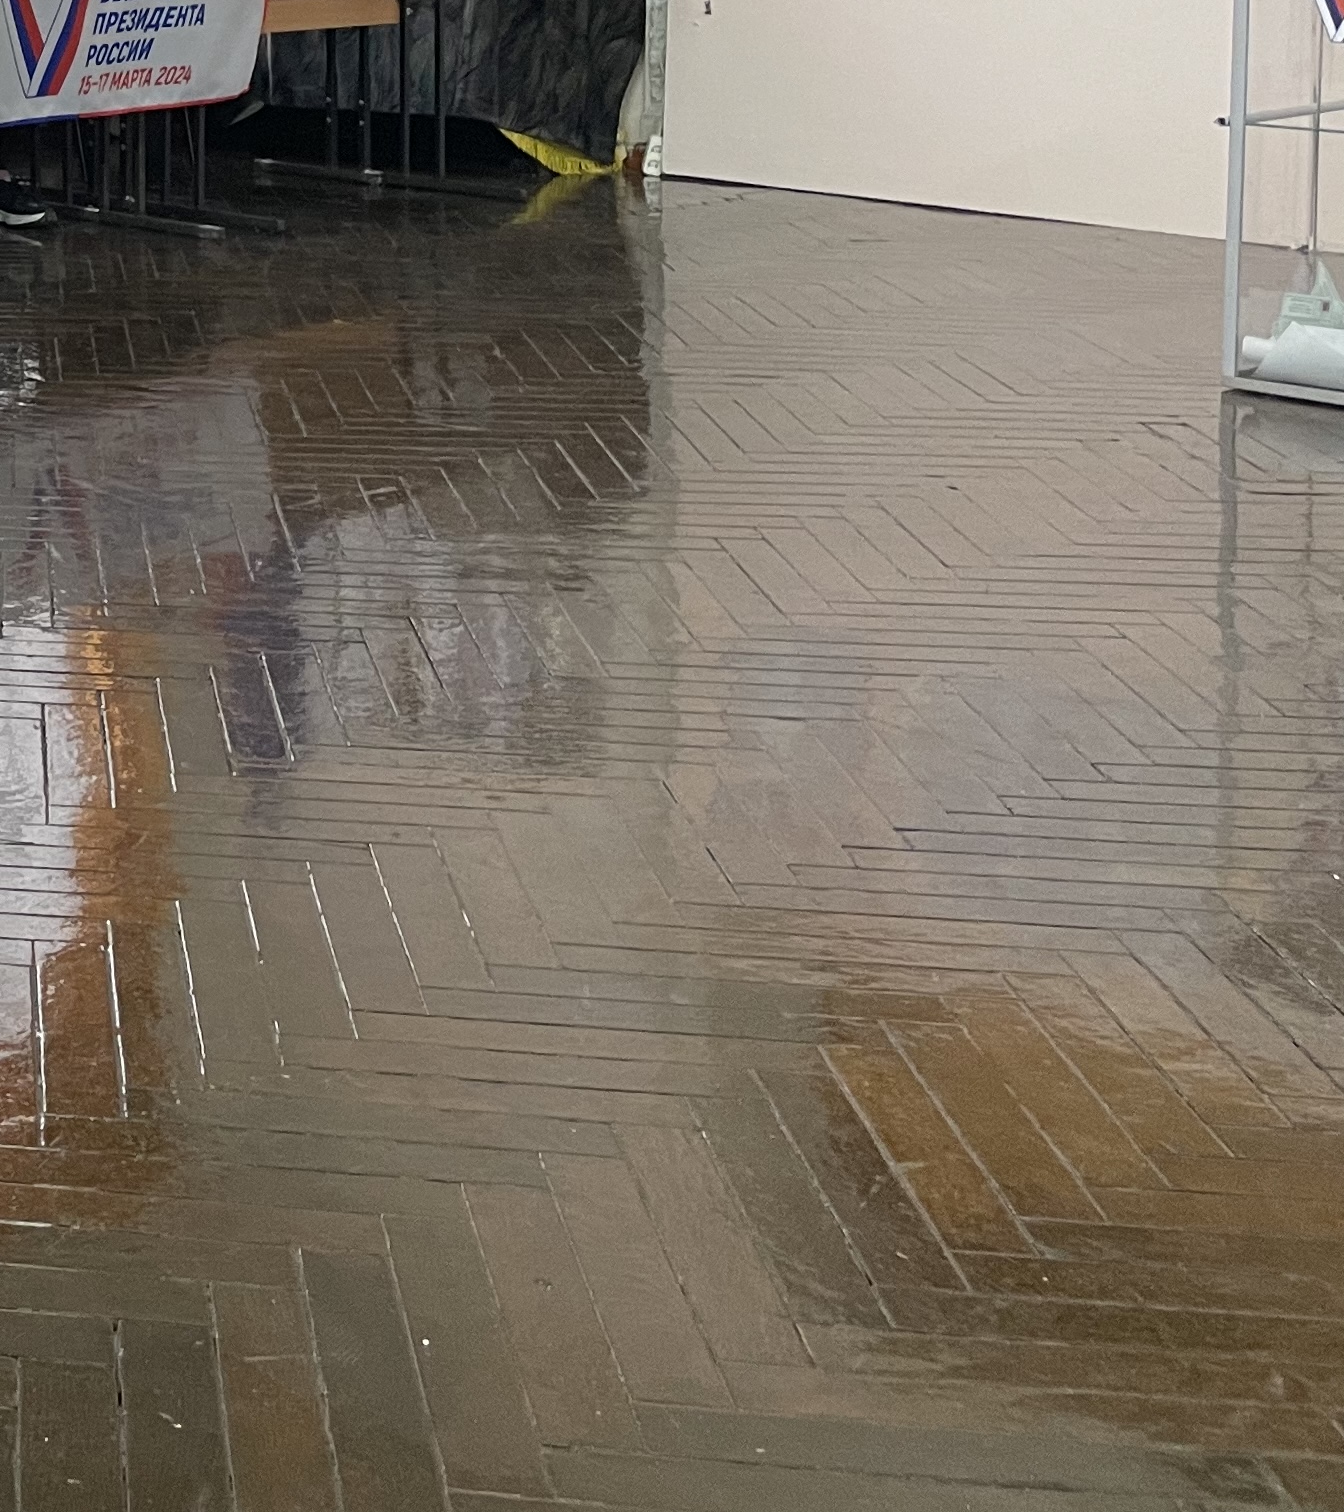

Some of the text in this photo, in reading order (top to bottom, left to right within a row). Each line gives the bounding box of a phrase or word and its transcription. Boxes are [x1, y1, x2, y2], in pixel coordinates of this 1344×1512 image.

[93, 3, 206, 35] ПРЕЗИДЕНТА
[84, 37, 156, 68] РОССИИ
[109, 67, 153, 92] МАРТА
[156, 64, 192, 88] 2024
